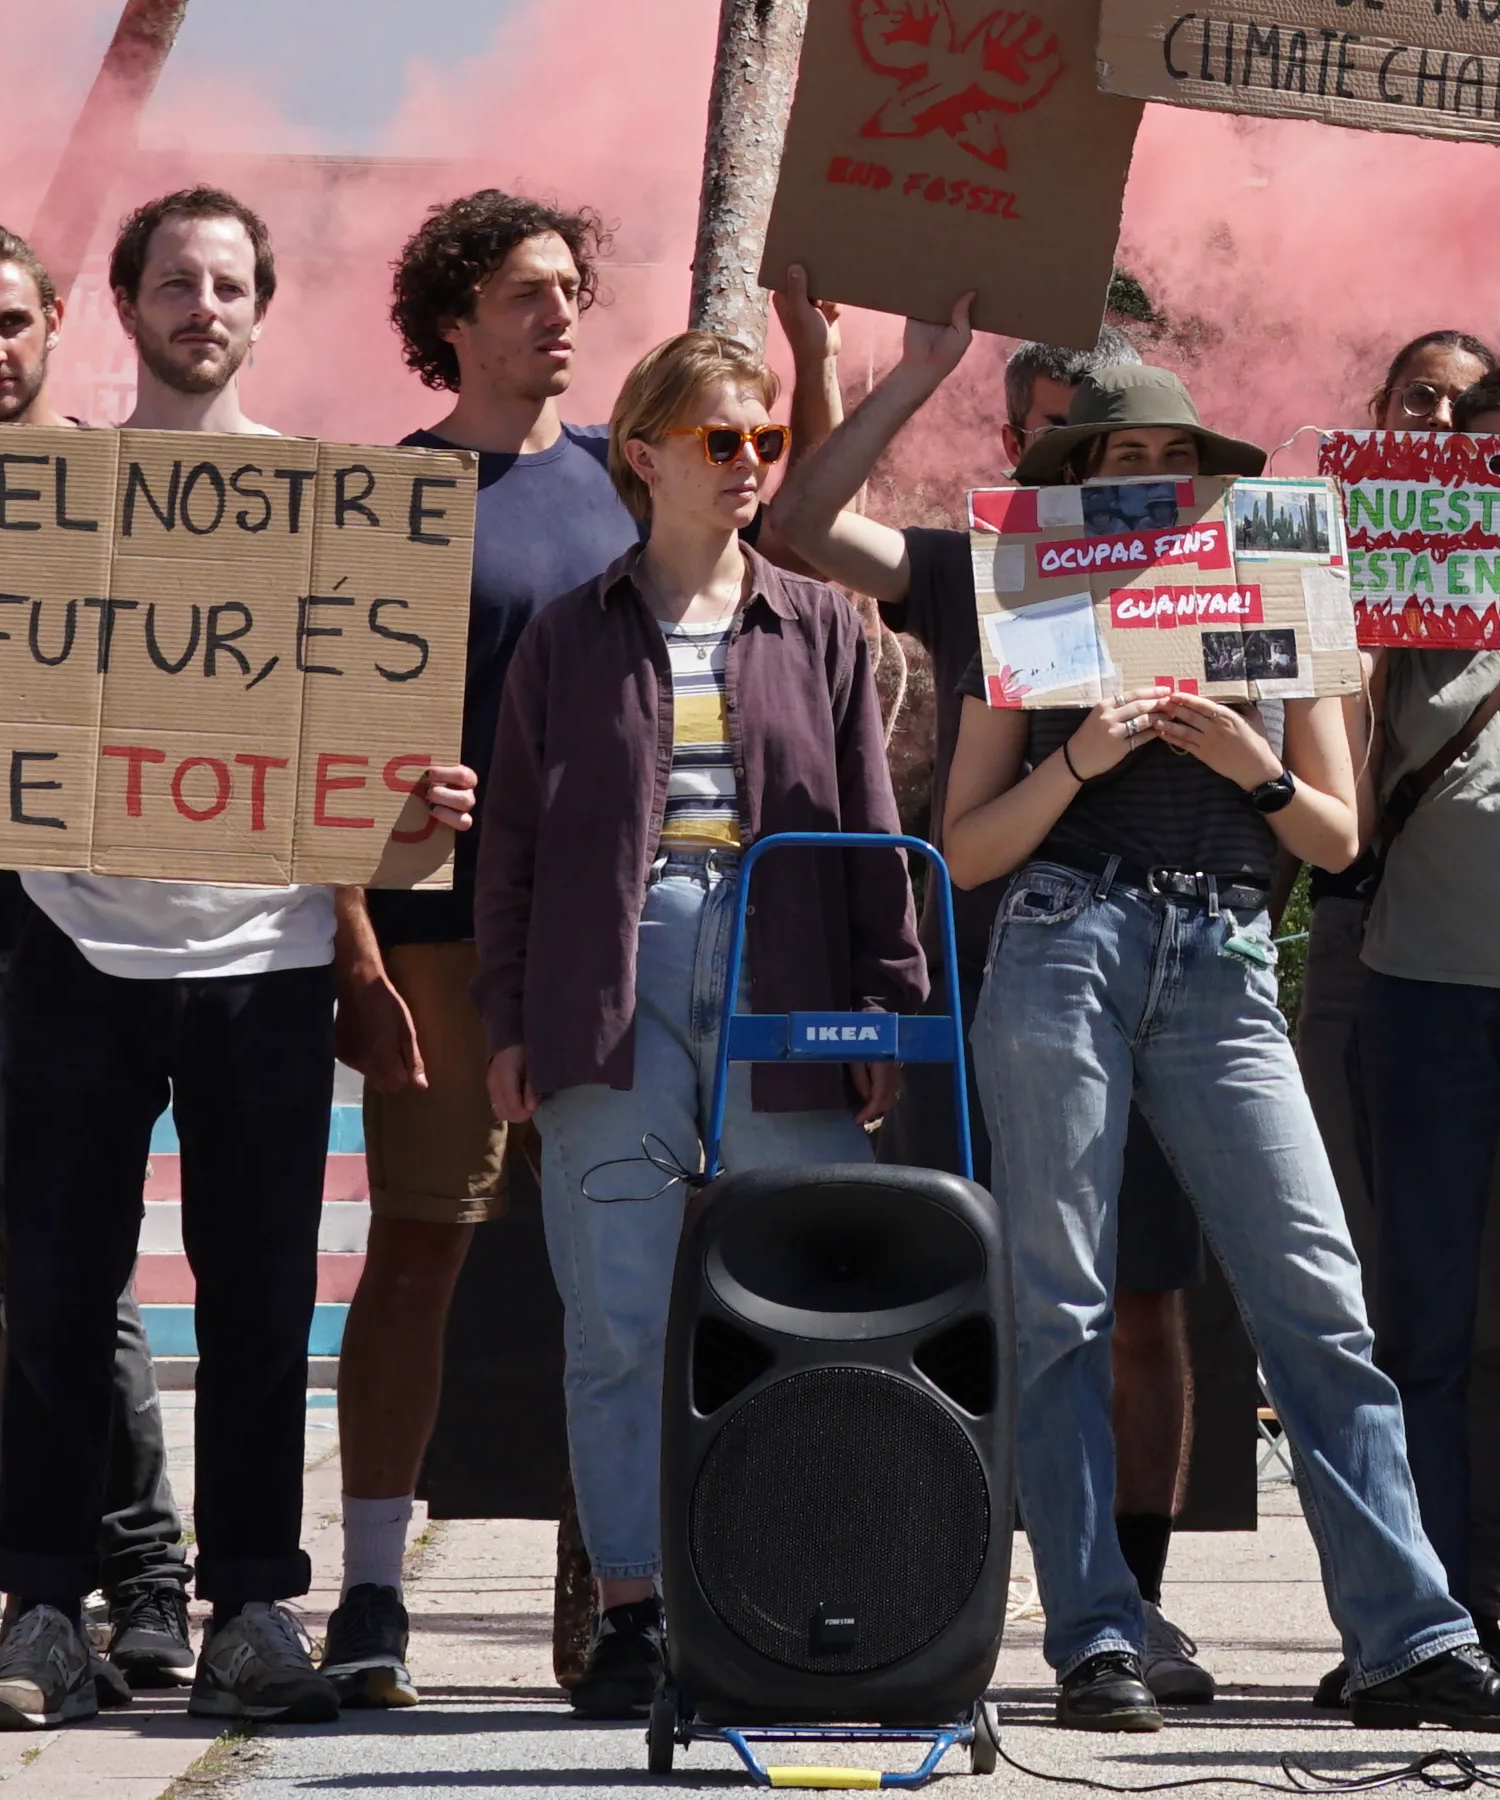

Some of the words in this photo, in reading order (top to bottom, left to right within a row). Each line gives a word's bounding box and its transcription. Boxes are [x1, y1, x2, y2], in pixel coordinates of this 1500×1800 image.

[1163, 13, 1363, 100] CLIMATE
[825, 156, 893, 190] END
[903, 172, 1022, 220] FOSSIL
[122, 460, 458, 546] NOSTRE
[1040, 541, 1149, 573] OCUPAR
[1153, 529, 1219, 559] FINS
[1348, 550, 1434, 594] ESTA
[296, 576, 430, 682] ÉS
[1115, 590, 1251, 620] GUANYAR!
[102, 744, 441, 845] TOTES
[806, 1026, 879, 1041] IKEA
